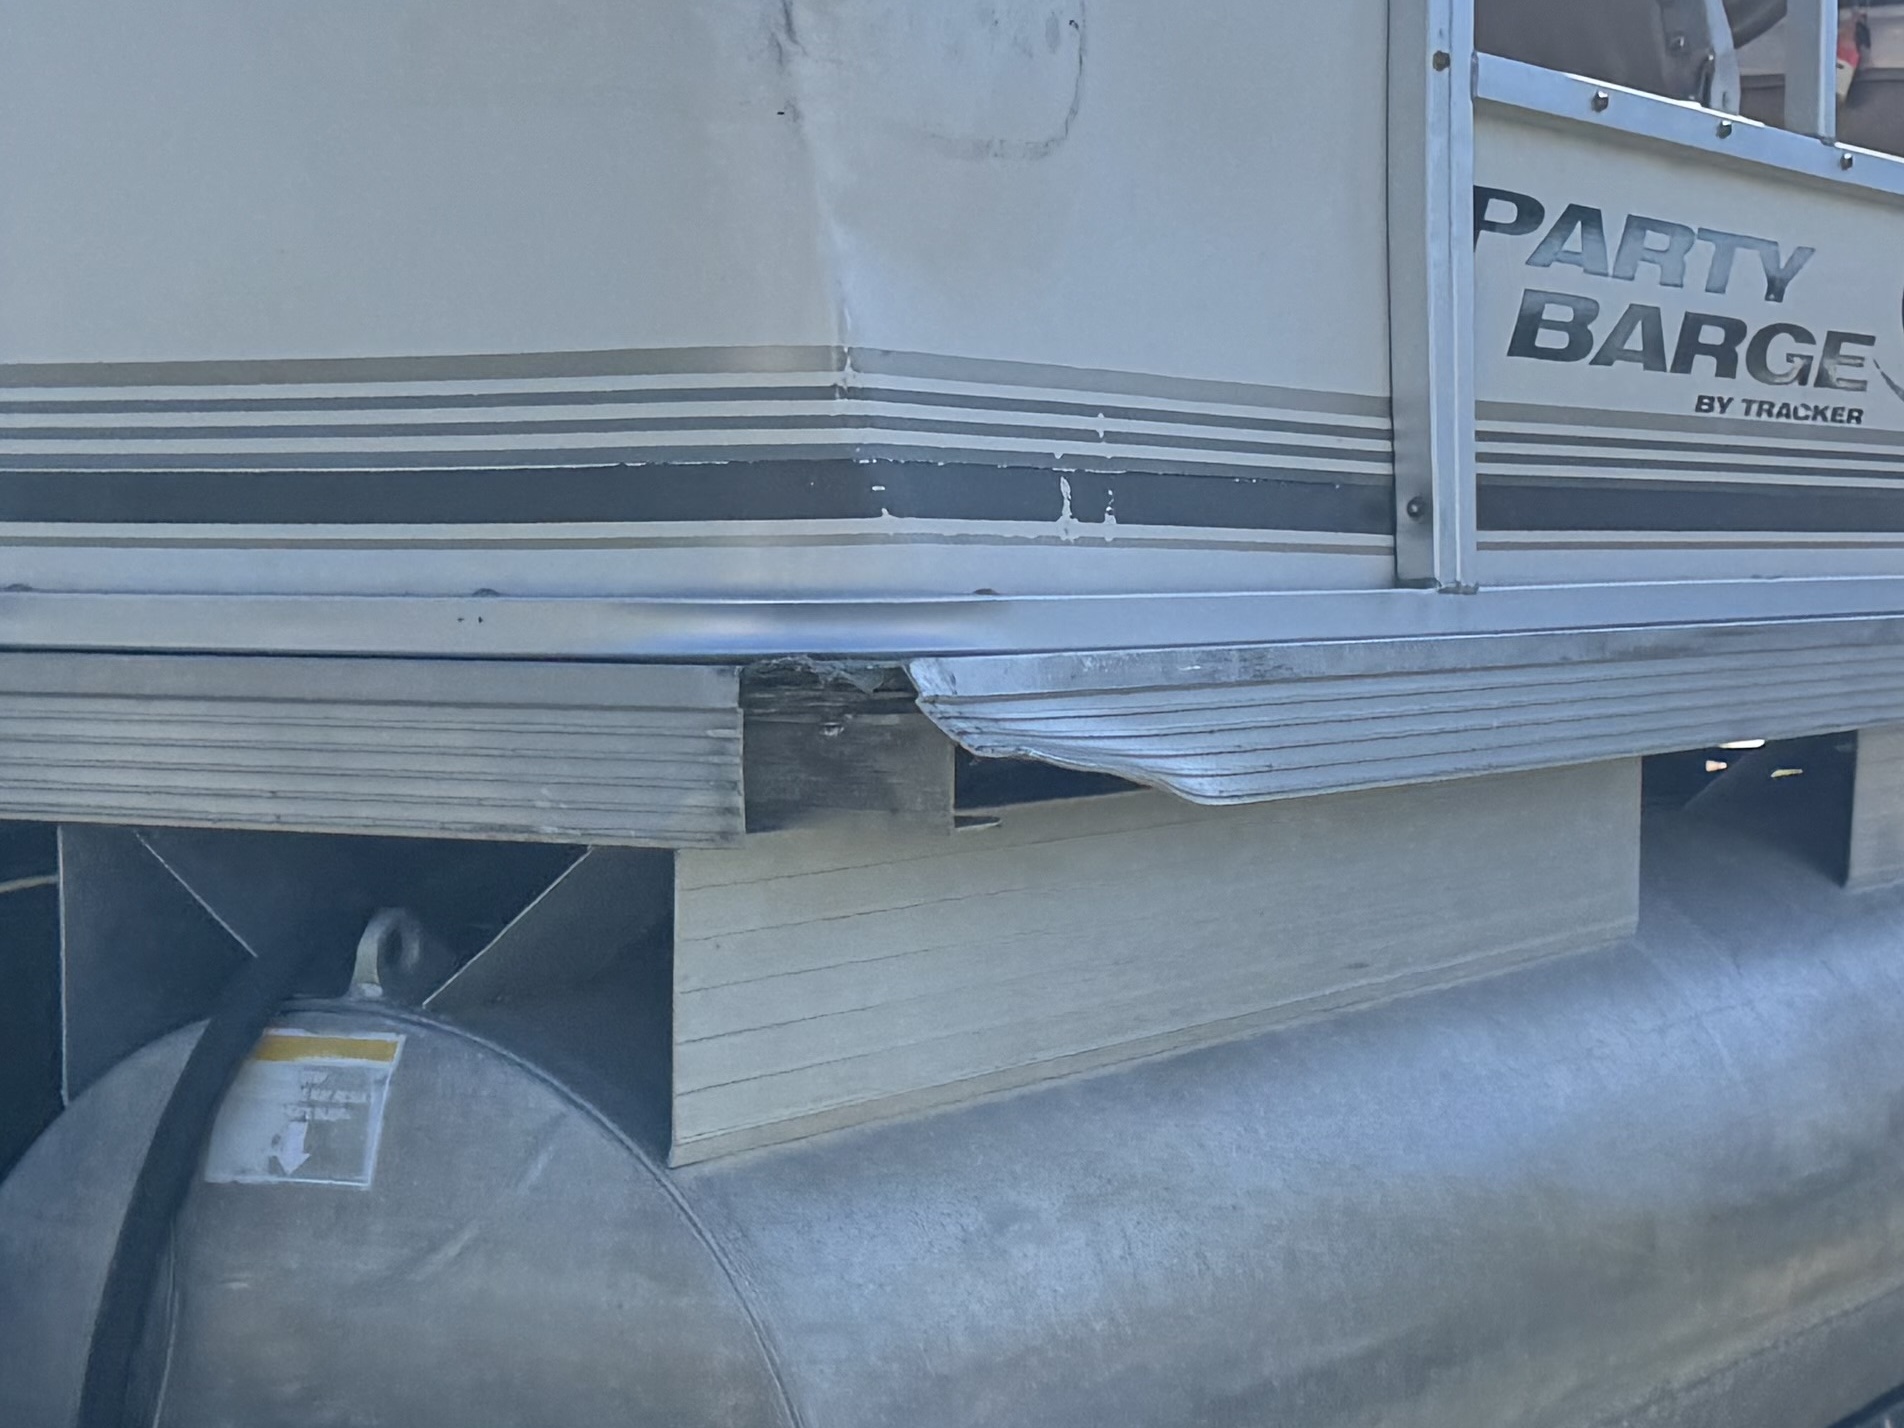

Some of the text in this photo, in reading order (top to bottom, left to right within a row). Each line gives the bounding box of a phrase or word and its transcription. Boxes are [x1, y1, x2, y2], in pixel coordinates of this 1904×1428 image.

[1473, 185, 1815, 303] PARTY
[1507, 289, 1876, 392] BARGE
[1695, 395, 1865, 425] BY TRACKER
